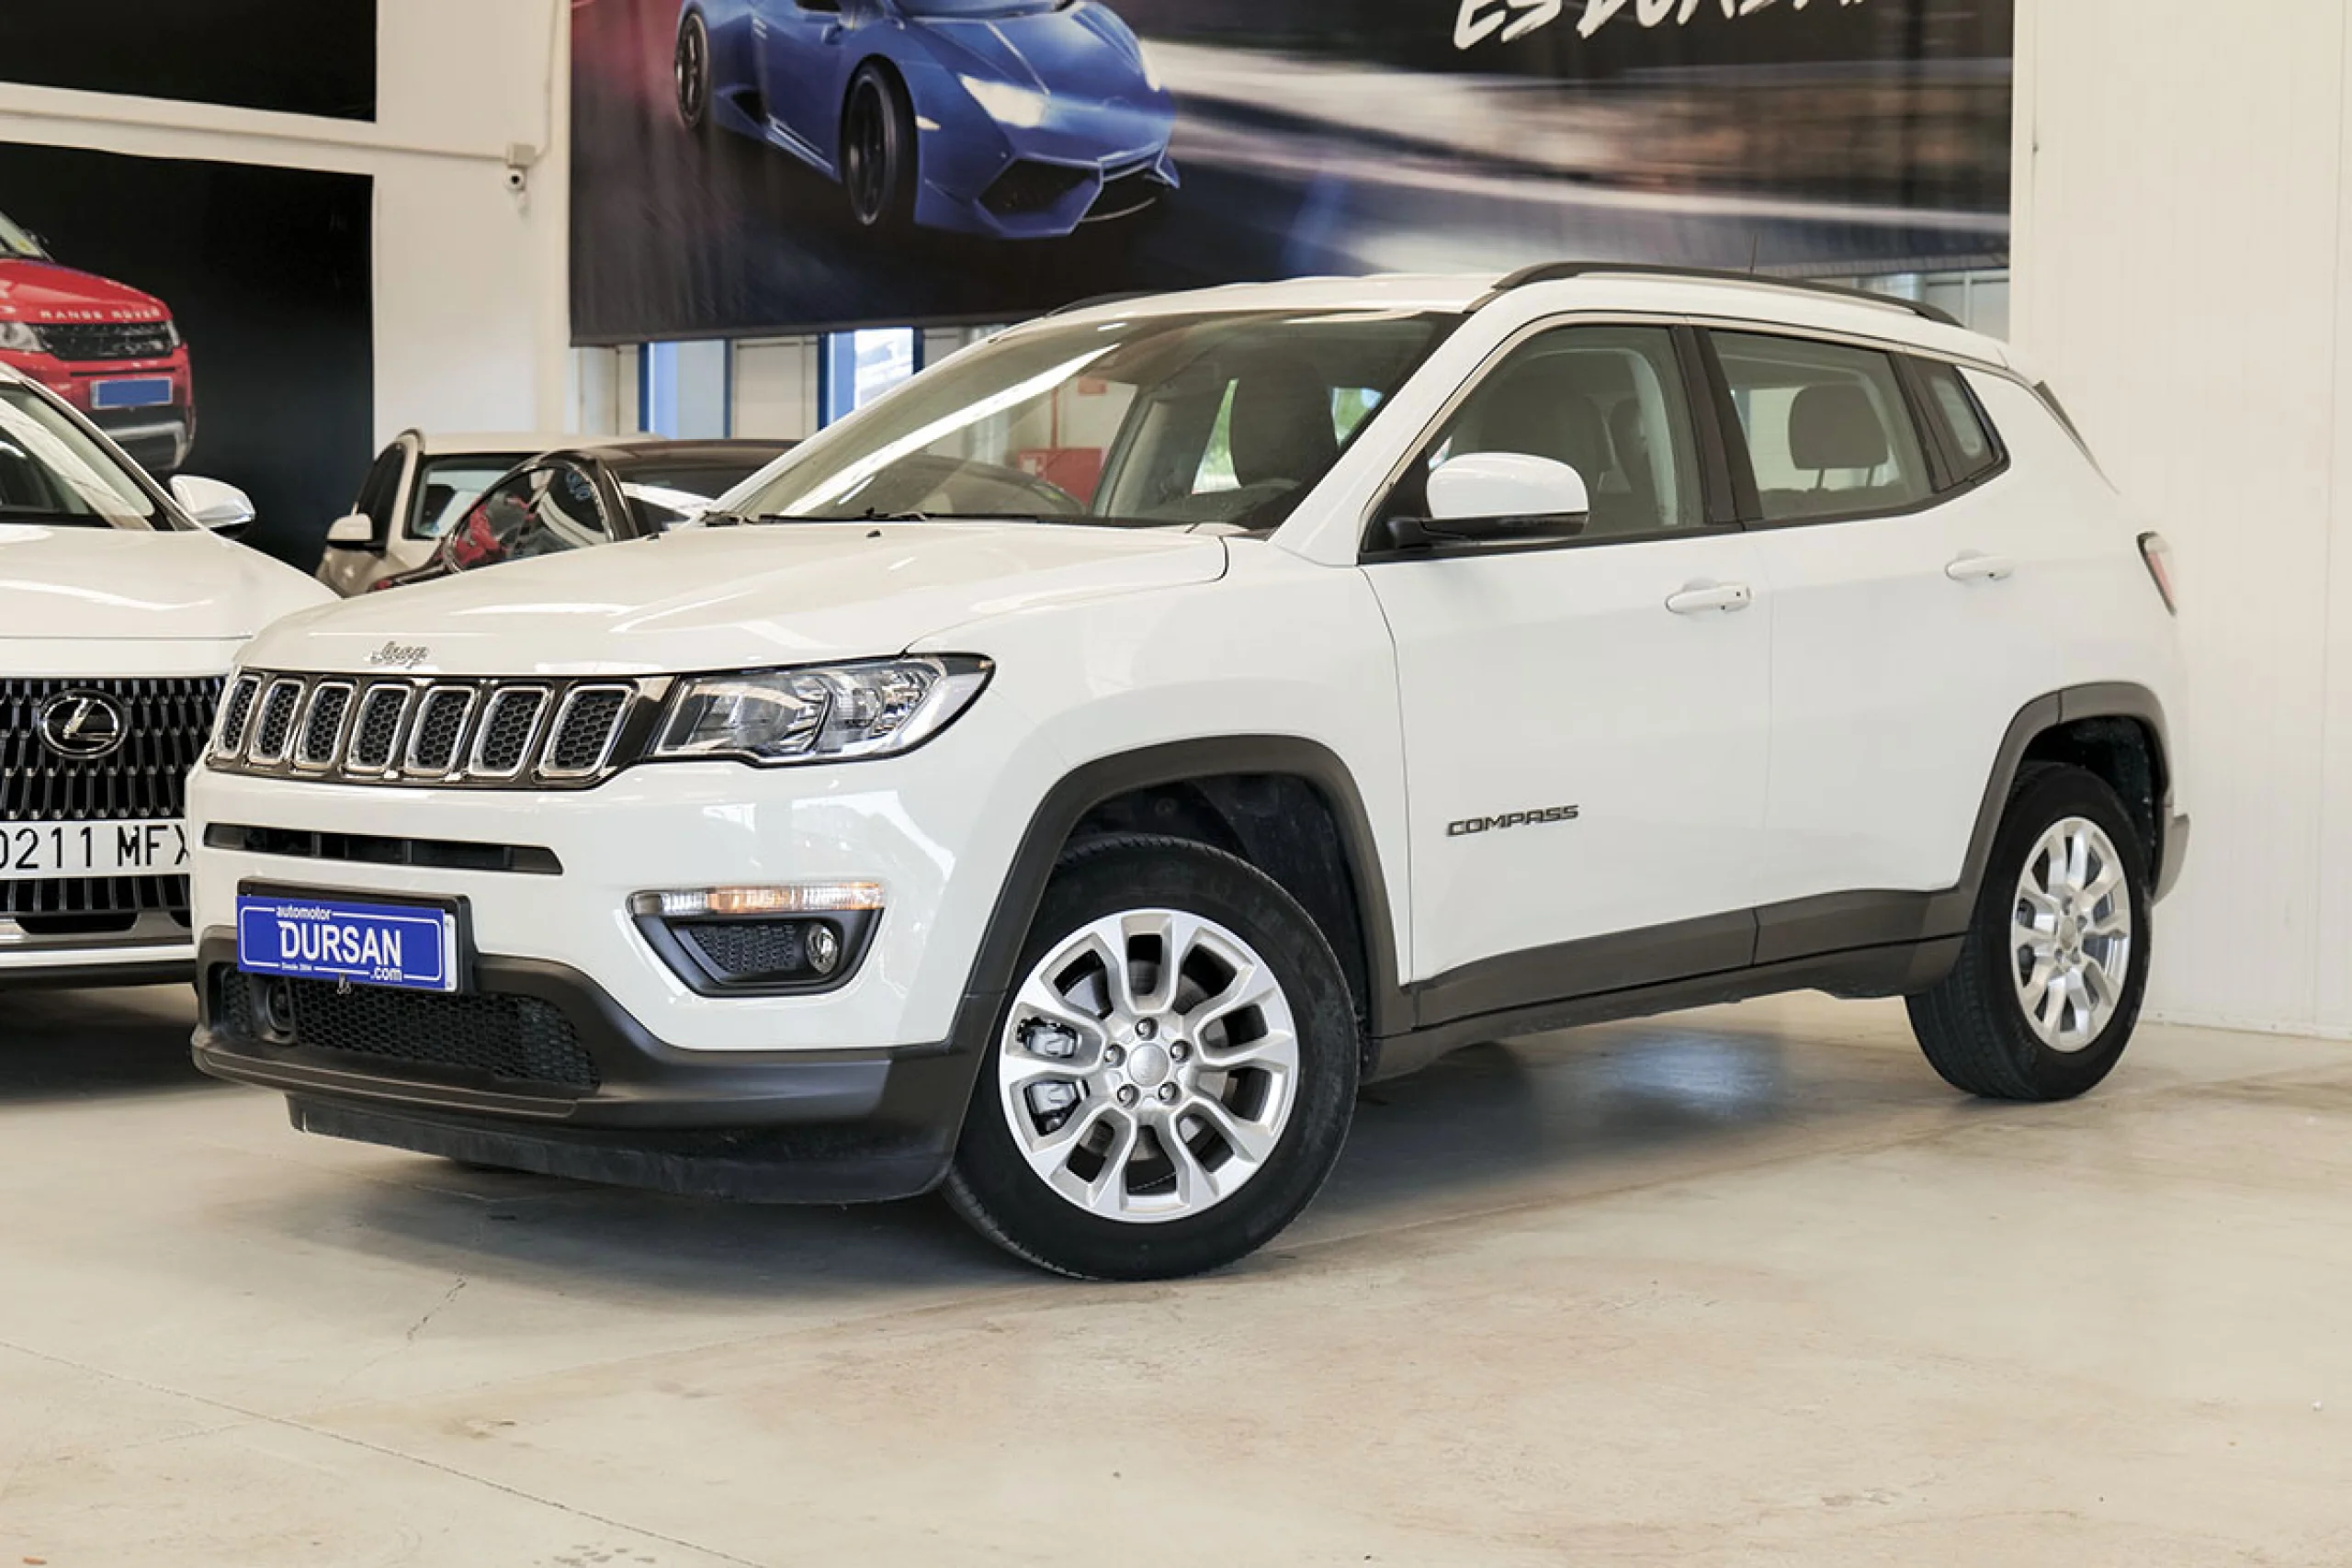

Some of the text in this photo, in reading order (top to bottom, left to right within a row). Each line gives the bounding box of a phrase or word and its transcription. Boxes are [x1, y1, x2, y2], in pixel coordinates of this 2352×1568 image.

[1446, 804, 1579, 837] COMPASS
[277, 904, 332, 920] automotor
[277, 920, 401, 967] DURSAN
[369, 965, 402, 982] .com
